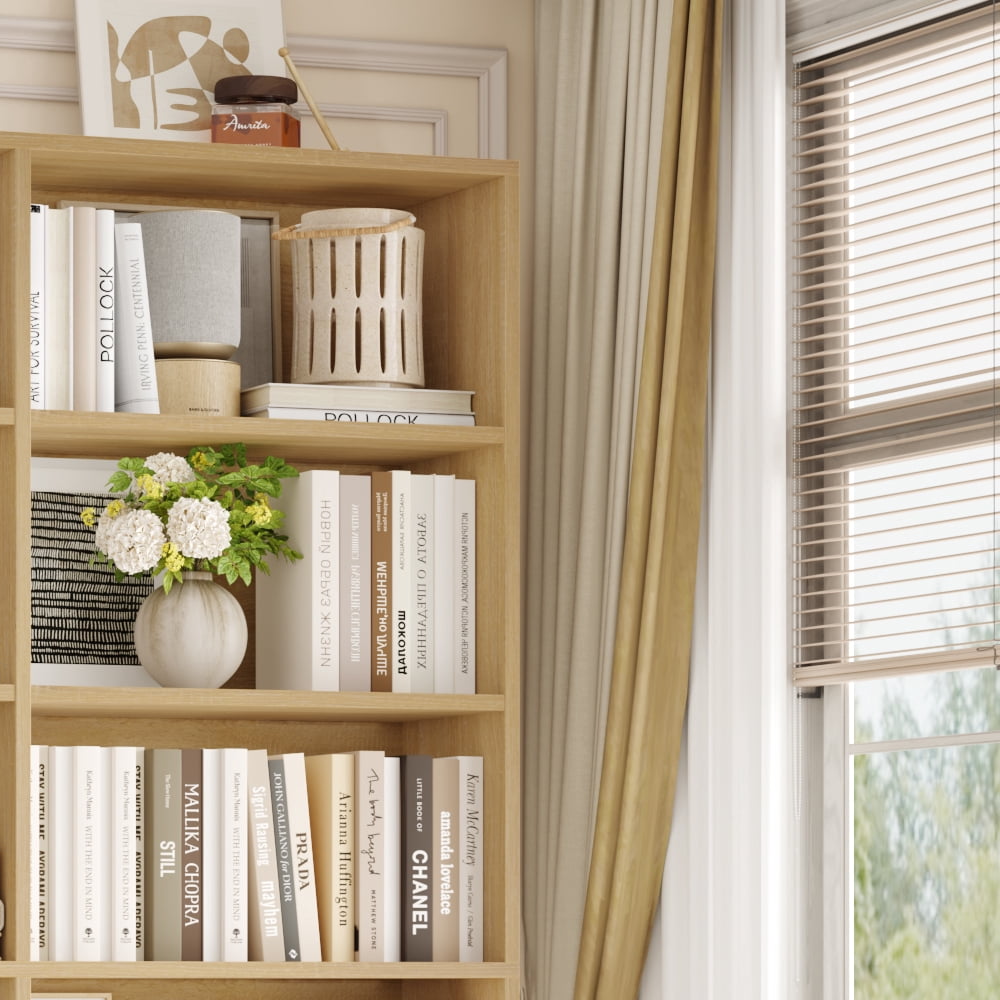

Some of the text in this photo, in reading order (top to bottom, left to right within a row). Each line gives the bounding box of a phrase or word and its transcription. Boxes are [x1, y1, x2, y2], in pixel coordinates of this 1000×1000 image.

[223, 114, 270, 132] Amrita
[99, 267, 114, 362] POLLOCK
[129, 256, 152, 391] IRVING PENN: CENTENNIAL
[467, 774, 478, 805] Karen
[85, 826, 93, 847] WITH
[232, 827, 240, 848] WITH
[251, 786, 271, 868] Sigrid Rausing
[273, 772, 293, 902] JOHN GALLIANO for DIOR
[361, 768, 383, 876] The body beyond
[417, 823, 423, 832] OF
[466, 809, 478, 866] McCartney
[85, 850, 93, 864] THE
[160, 841, 175, 877] STILL
[185, 784, 199, 927] MALLIKA CHOPRA
[232, 852, 240, 866] THE
[296, 832, 310, 890] PRADA
[336, 792, 352, 927] Arianna Huffington
[441, 811, 452, 915] amanda lovelace
[85, 867, 93, 885] END
[85, 886, 92, 895] IN
[122, 887, 129, 896] IN
[233, 888, 240, 897] IN
[412, 850, 428, 935] CHANEL
[85, 898, 93, 920] MIND
[232, 899, 240, 921] MIND
[261, 881, 280, 936] mayhem
